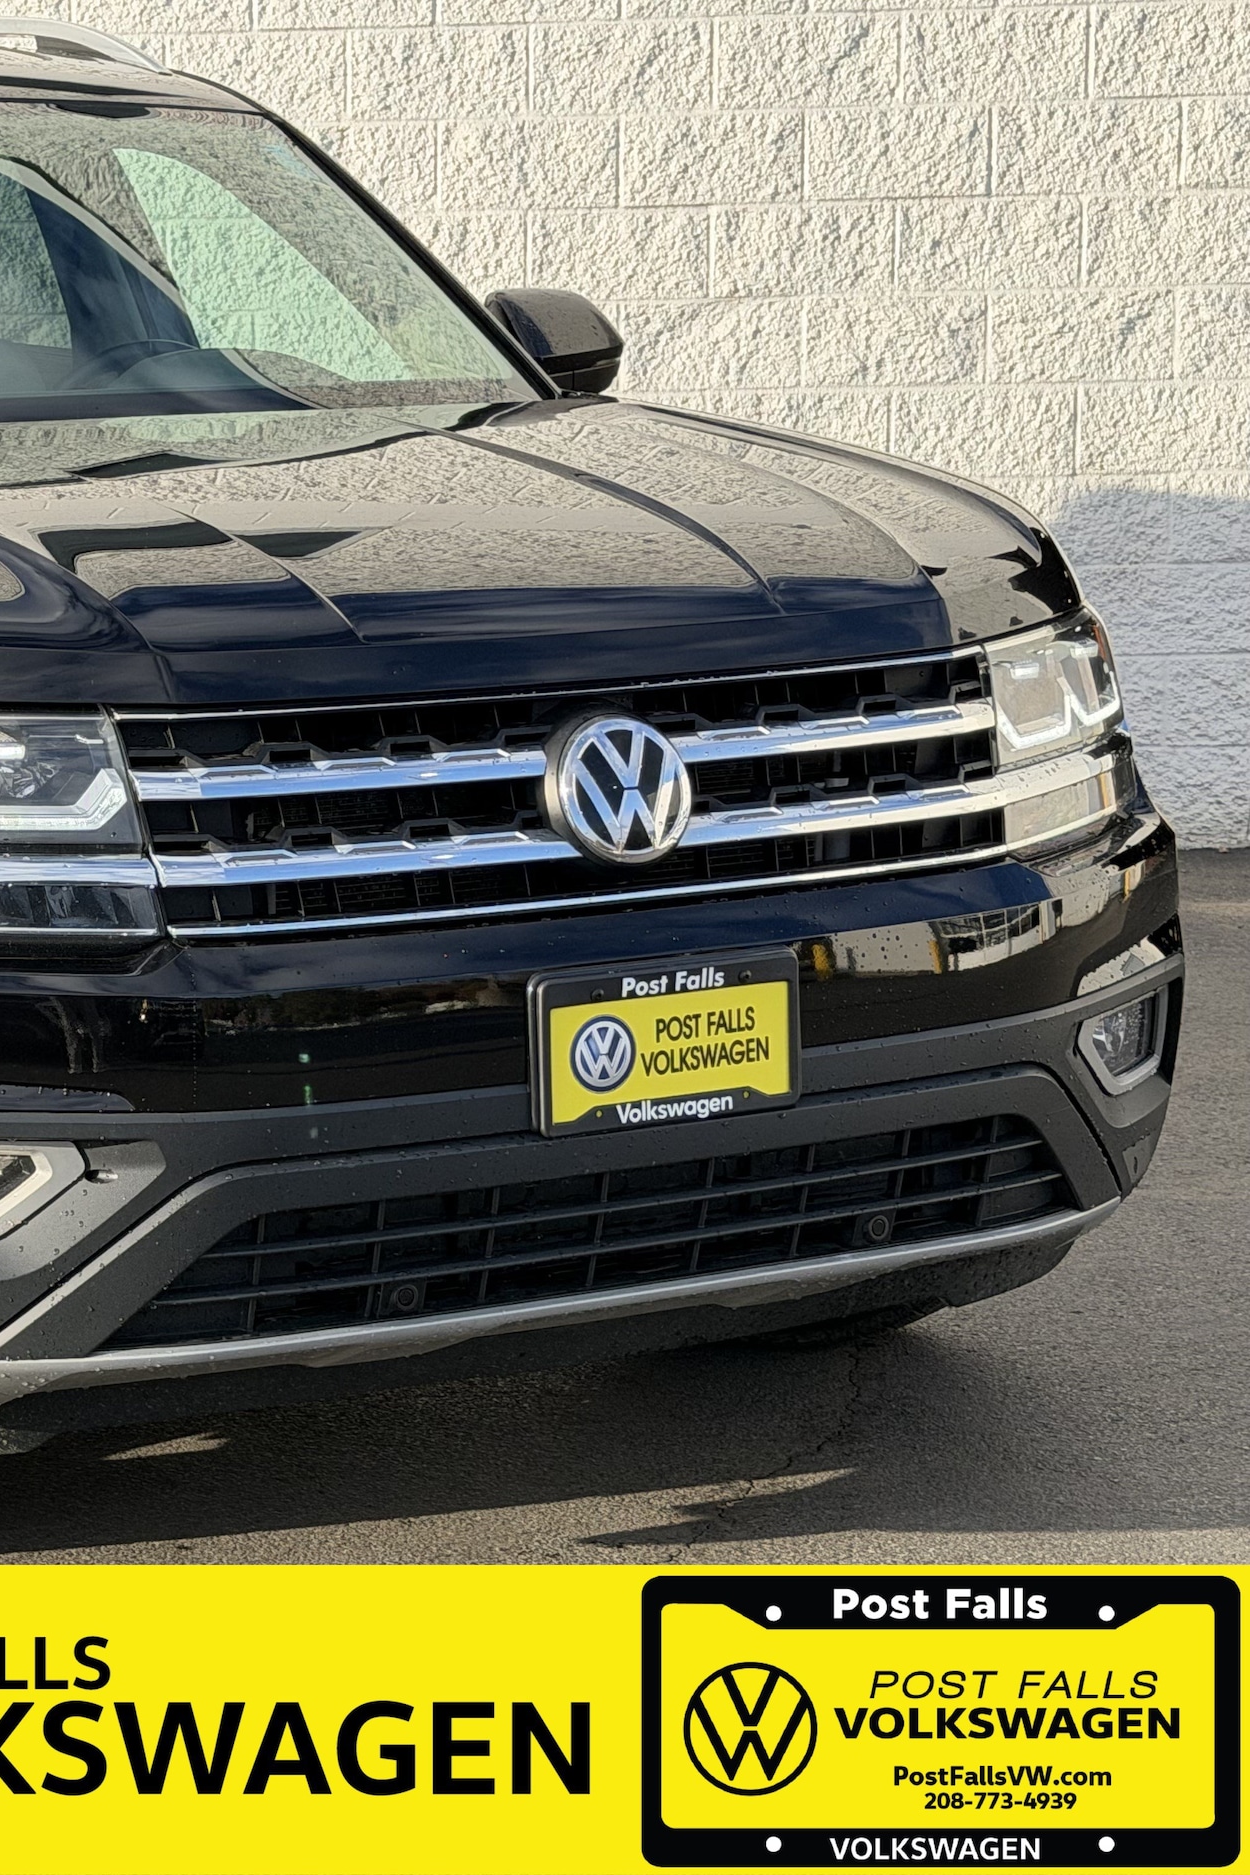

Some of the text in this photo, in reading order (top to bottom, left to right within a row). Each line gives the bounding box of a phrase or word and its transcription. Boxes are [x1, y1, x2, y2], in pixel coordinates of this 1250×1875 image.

[621, 966, 725, 998] Post Falls
[655, 1006, 755, 1043] POST FALLS
[640, 1036, 769, 1077] VOLKSWAGEN
[616, 1095, 733, 1124] Volkswagen
